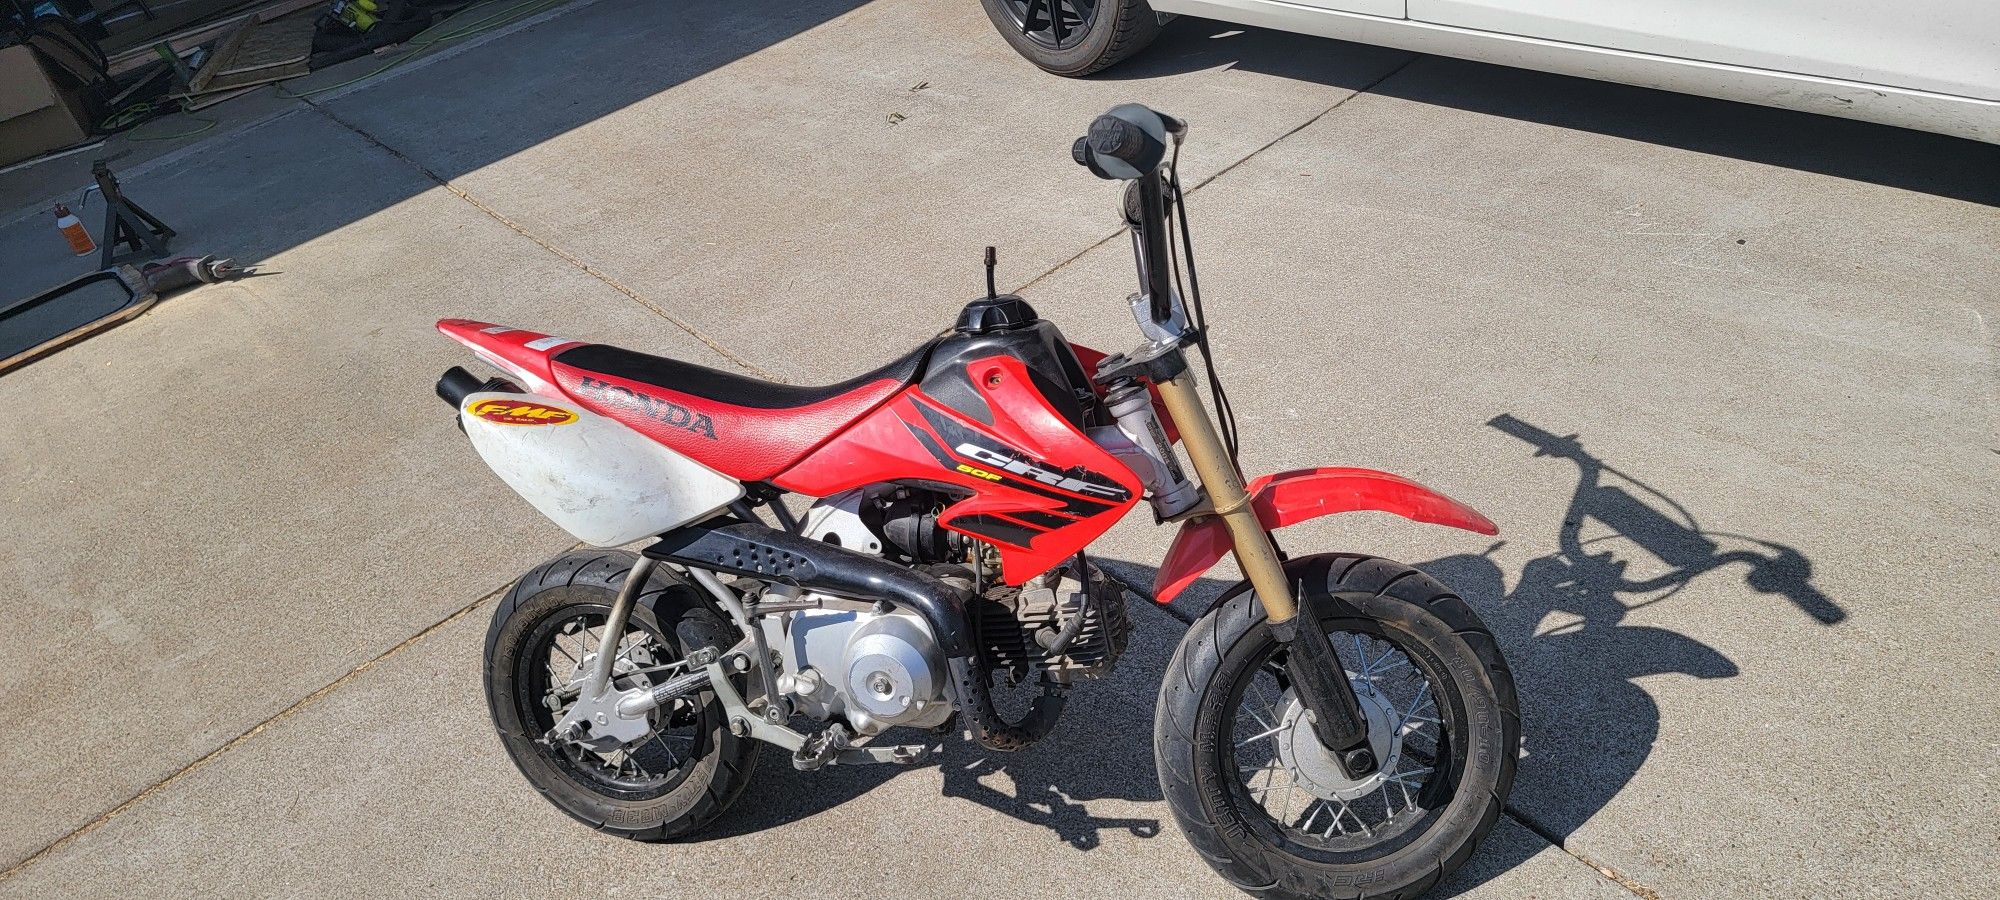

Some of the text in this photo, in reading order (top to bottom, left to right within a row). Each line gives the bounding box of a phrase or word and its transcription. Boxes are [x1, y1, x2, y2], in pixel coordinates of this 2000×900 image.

[474, 404, 572, 419] FMF
[581, 376, 718, 440] HONDA
[956, 443, 1126, 496] CRF
[956, 464, 1002, 481] 50F
